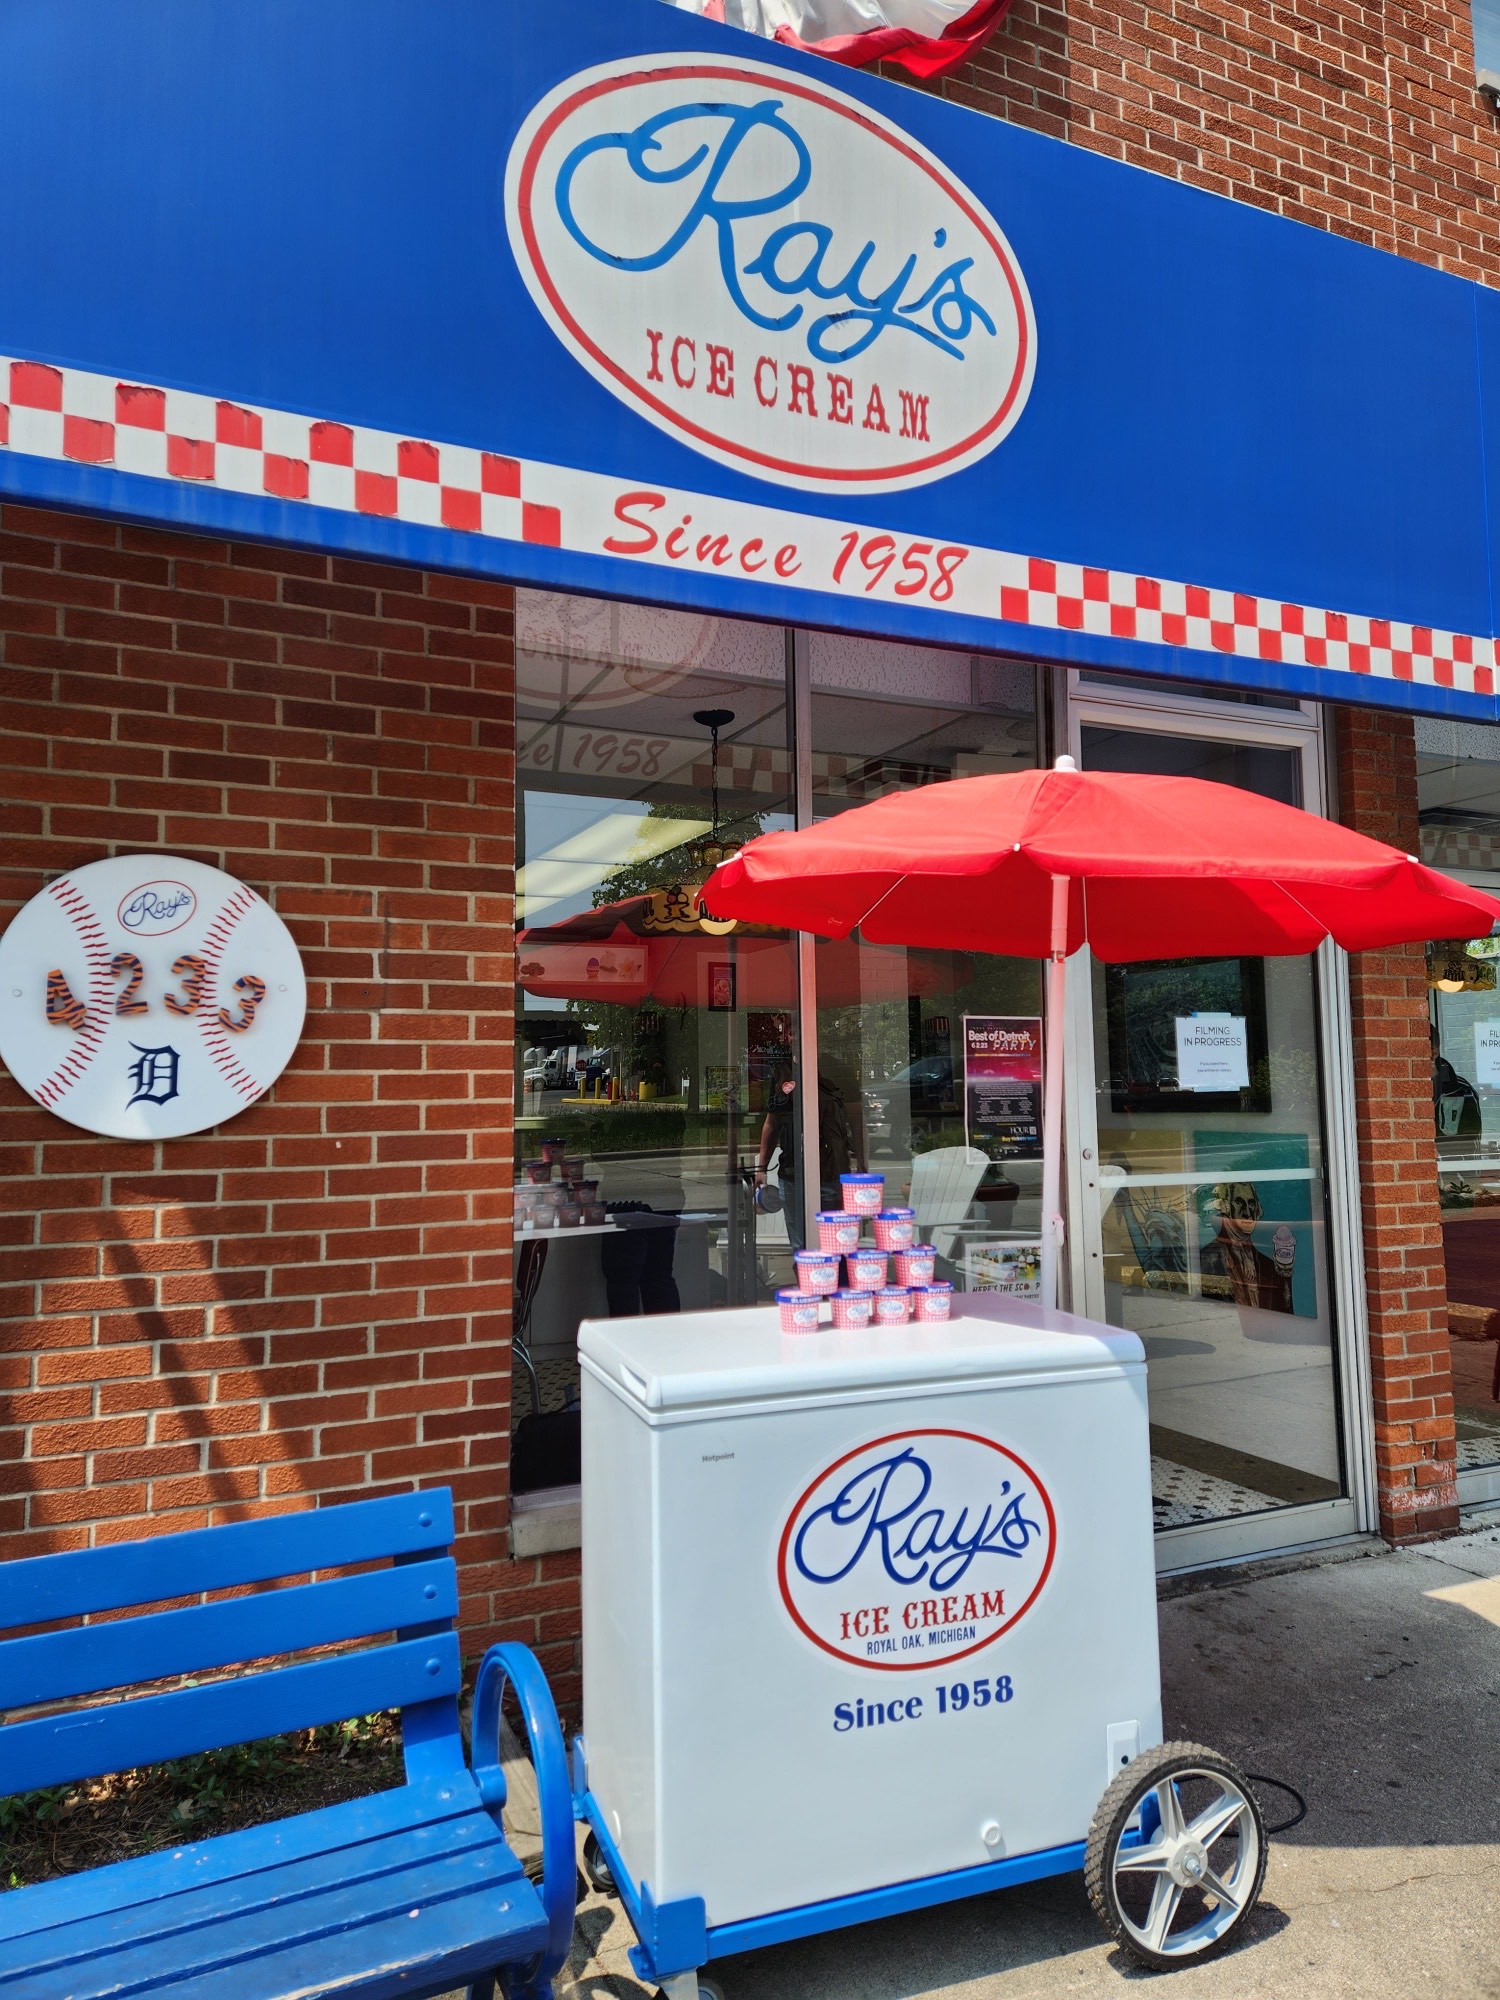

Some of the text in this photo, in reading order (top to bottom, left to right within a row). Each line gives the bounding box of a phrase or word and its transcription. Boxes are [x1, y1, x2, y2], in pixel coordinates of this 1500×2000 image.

[555, 100, 997, 363] Ray's
[646, 328, 931, 443] ICE CREAM
[602, 491, 969, 602] Since 1958
[572, 732, 670, 776] 1958
[122, 890, 192, 927] Ray's
[968, 1030, 1030, 1041] Best of Detroit
[993, 1040, 1036, 1050] PARTY
[1184, 1038, 1242, 1046] IN PROGRESS
[1195, 1027, 1230, 1035] FILMING
[1480, 1039, 1488, 1047] IN
[1000, 1284, 1012, 1292] THE
[702, 1452, 735, 1462] Hotpoint
[794, 1447, 1041, 1591] Ray's
[840, 1589, 1006, 1640] ICE CREAM
[866, 1625, 976, 1656] ROYAL OAK, MICHIGAN
[833, 1675, 1015, 1732] Since 1958
